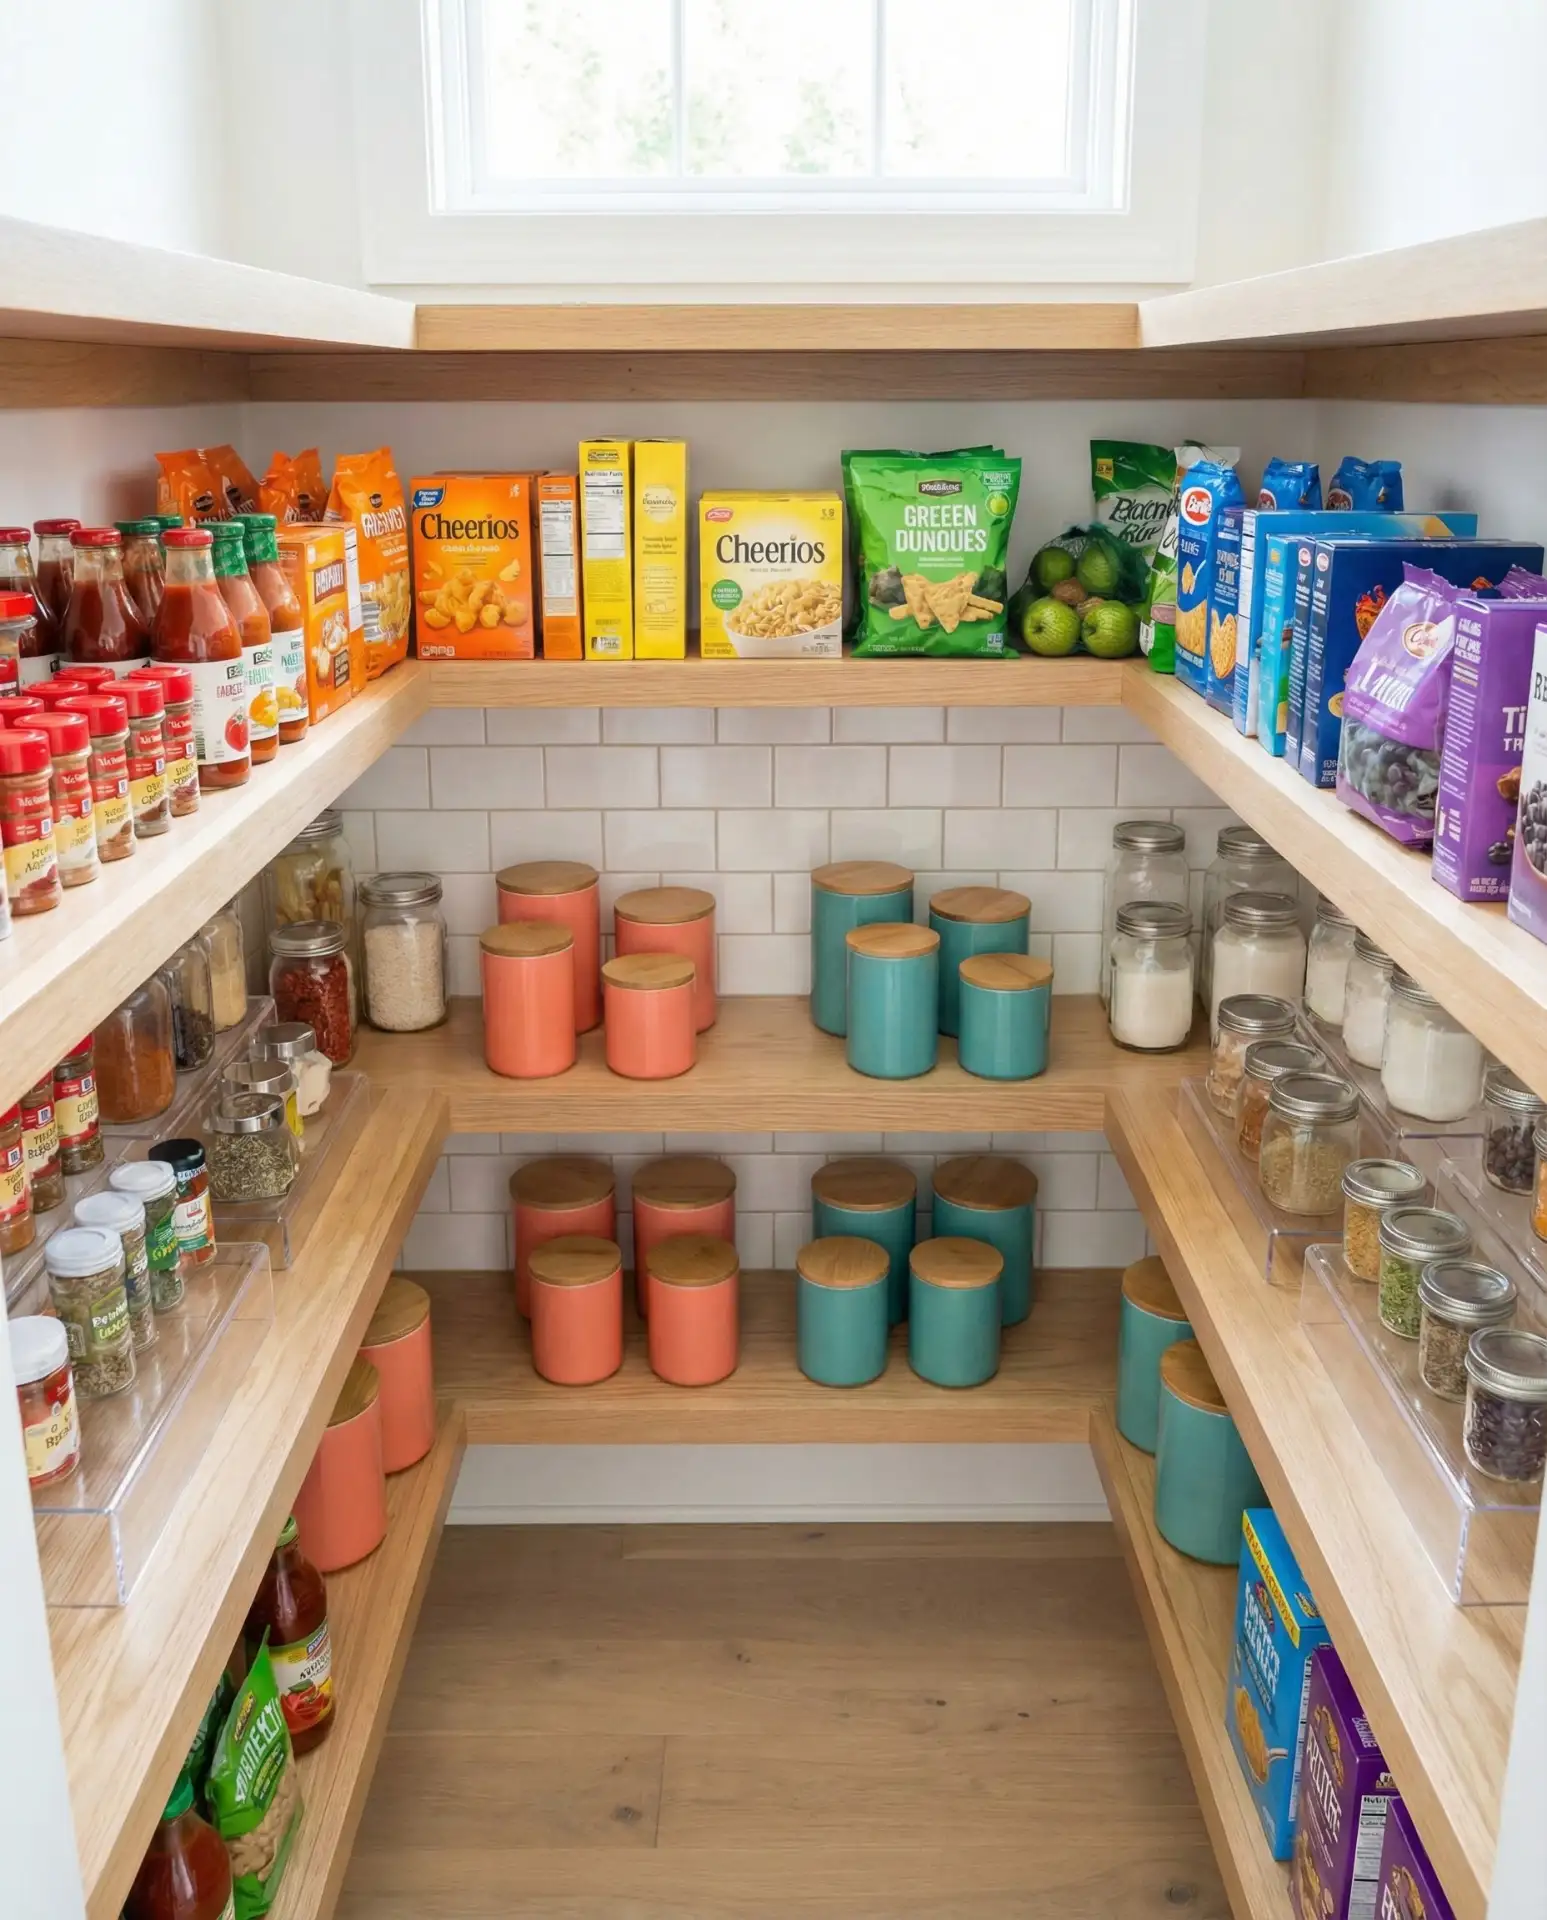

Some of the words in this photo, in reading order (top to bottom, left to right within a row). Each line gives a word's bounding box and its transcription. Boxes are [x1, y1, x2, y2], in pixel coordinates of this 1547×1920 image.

[420, 513, 520, 540] Cheerios
[904, 504, 977, 528] GREEEN
[716, 534, 826, 564] Cheerios
